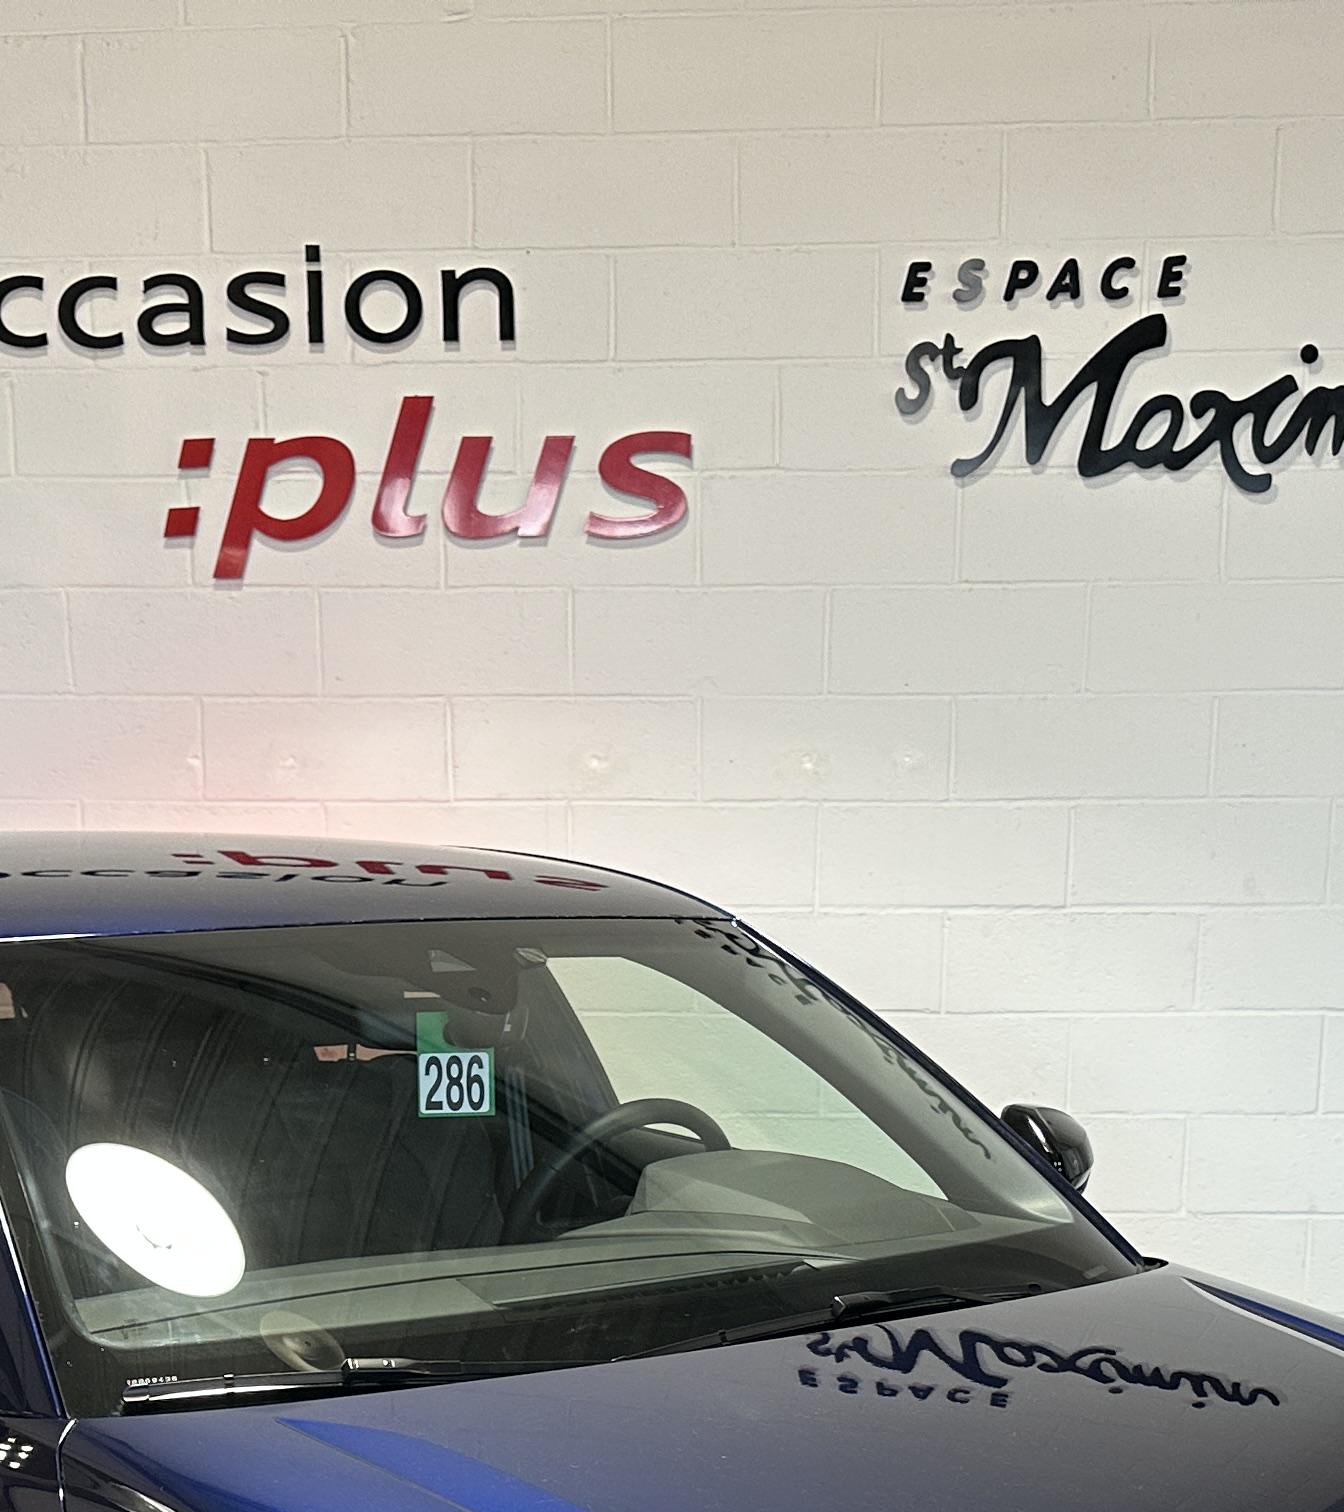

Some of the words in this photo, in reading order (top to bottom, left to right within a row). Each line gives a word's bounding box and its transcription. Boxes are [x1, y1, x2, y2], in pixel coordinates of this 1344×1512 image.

[901, 255, 1187, 302] ESPACE
[895, 333, 965, 415] St
[164, 396, 692, 580] :plus
[425, 1055, 485, 1111] 286
